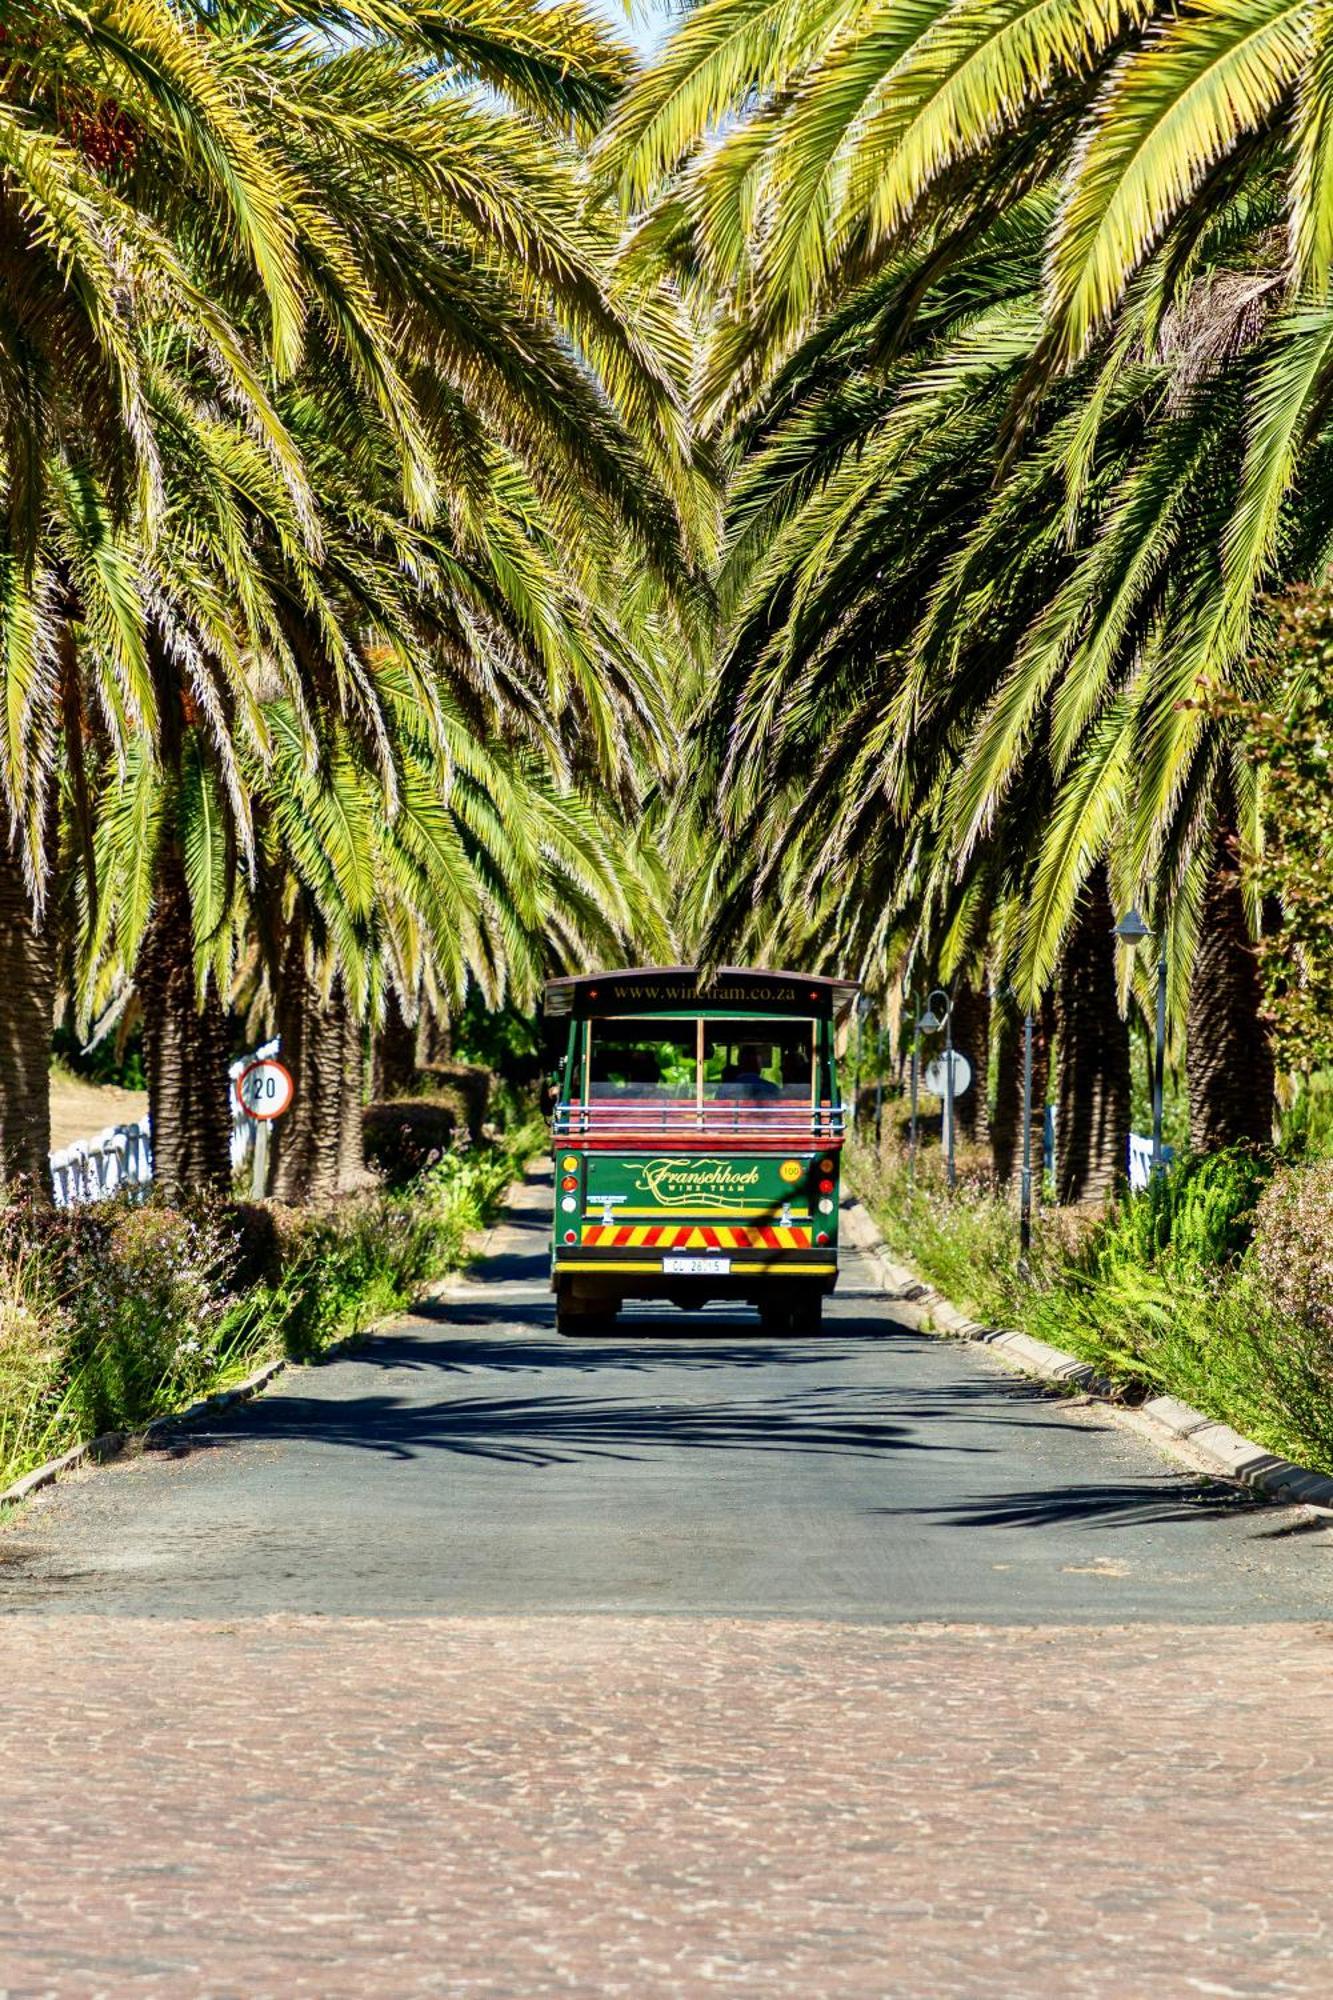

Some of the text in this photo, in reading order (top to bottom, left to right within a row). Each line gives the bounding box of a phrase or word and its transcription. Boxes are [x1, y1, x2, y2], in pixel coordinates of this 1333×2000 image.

[253, 1077, 276, 1099] 20
[641, 1158, 760, 1186] Franschhoek
[668, 1184, 701, 1192] WINE
